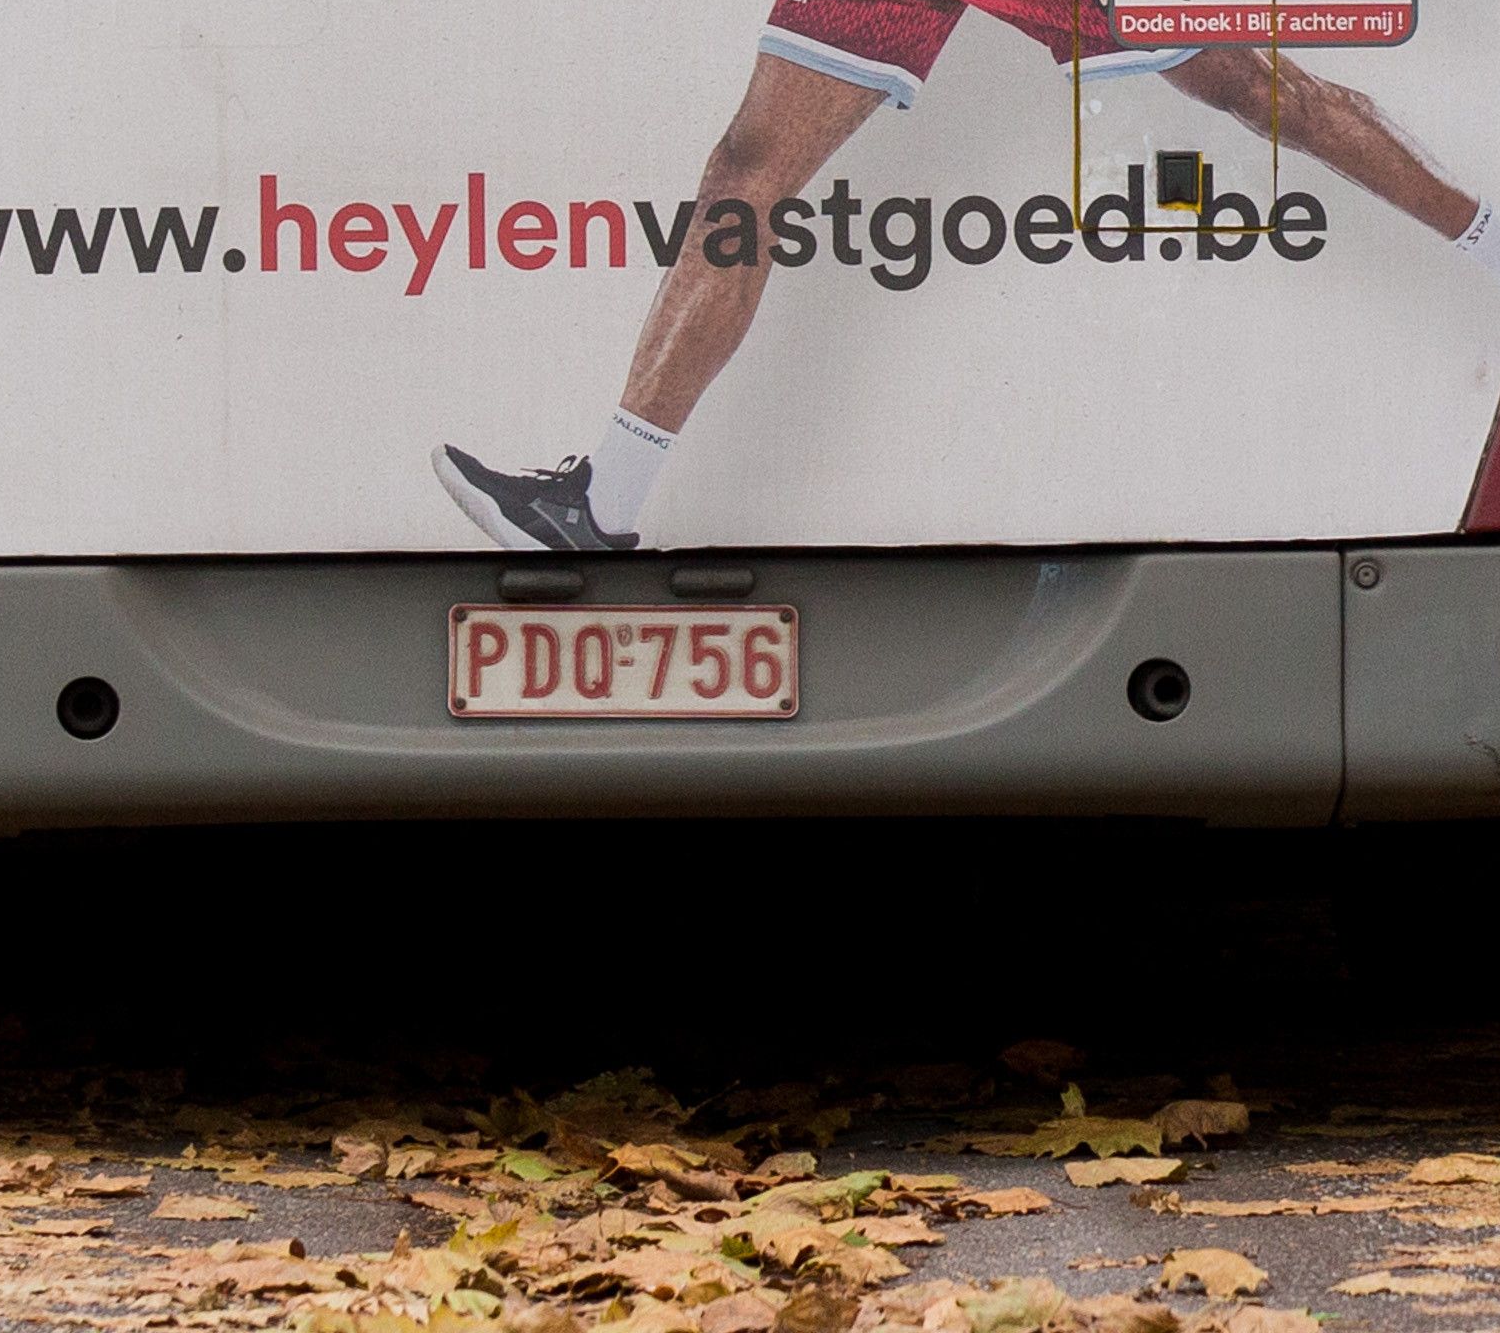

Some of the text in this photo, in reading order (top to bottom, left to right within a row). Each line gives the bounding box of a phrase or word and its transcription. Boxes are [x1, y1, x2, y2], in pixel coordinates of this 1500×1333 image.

[1120, 13, 1175, 34] Dode
[1247, 12, 1285, 36] Blijf
[1289, 13, 1359, 32] achter
